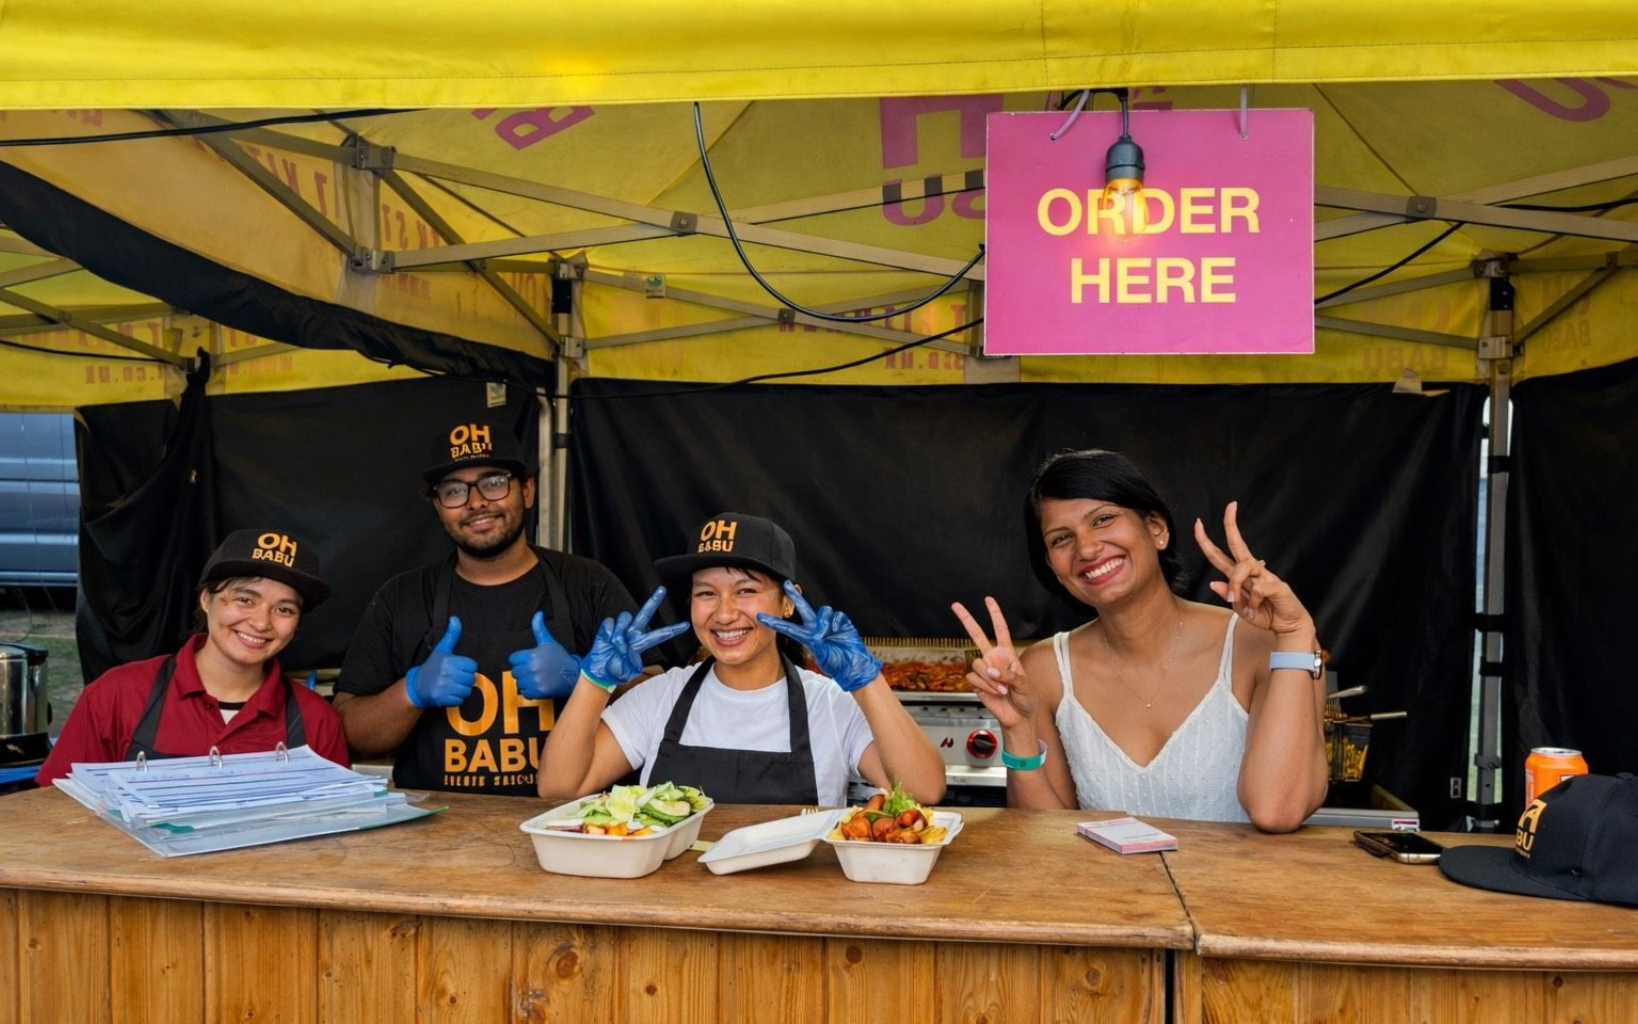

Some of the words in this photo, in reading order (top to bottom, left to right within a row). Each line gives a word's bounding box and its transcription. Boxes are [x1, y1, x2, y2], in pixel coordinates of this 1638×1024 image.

[1037, 187, 1261, 236] ORDER
[1071, 256, 1237, 304] HERE
[450, 424, 490, 446] OH
[700, 520, 738, 542] OH
[252, 548, 295, 568] BABU
[257, 532, 298, 558] OH
[445, 670, 555, 737] OH
